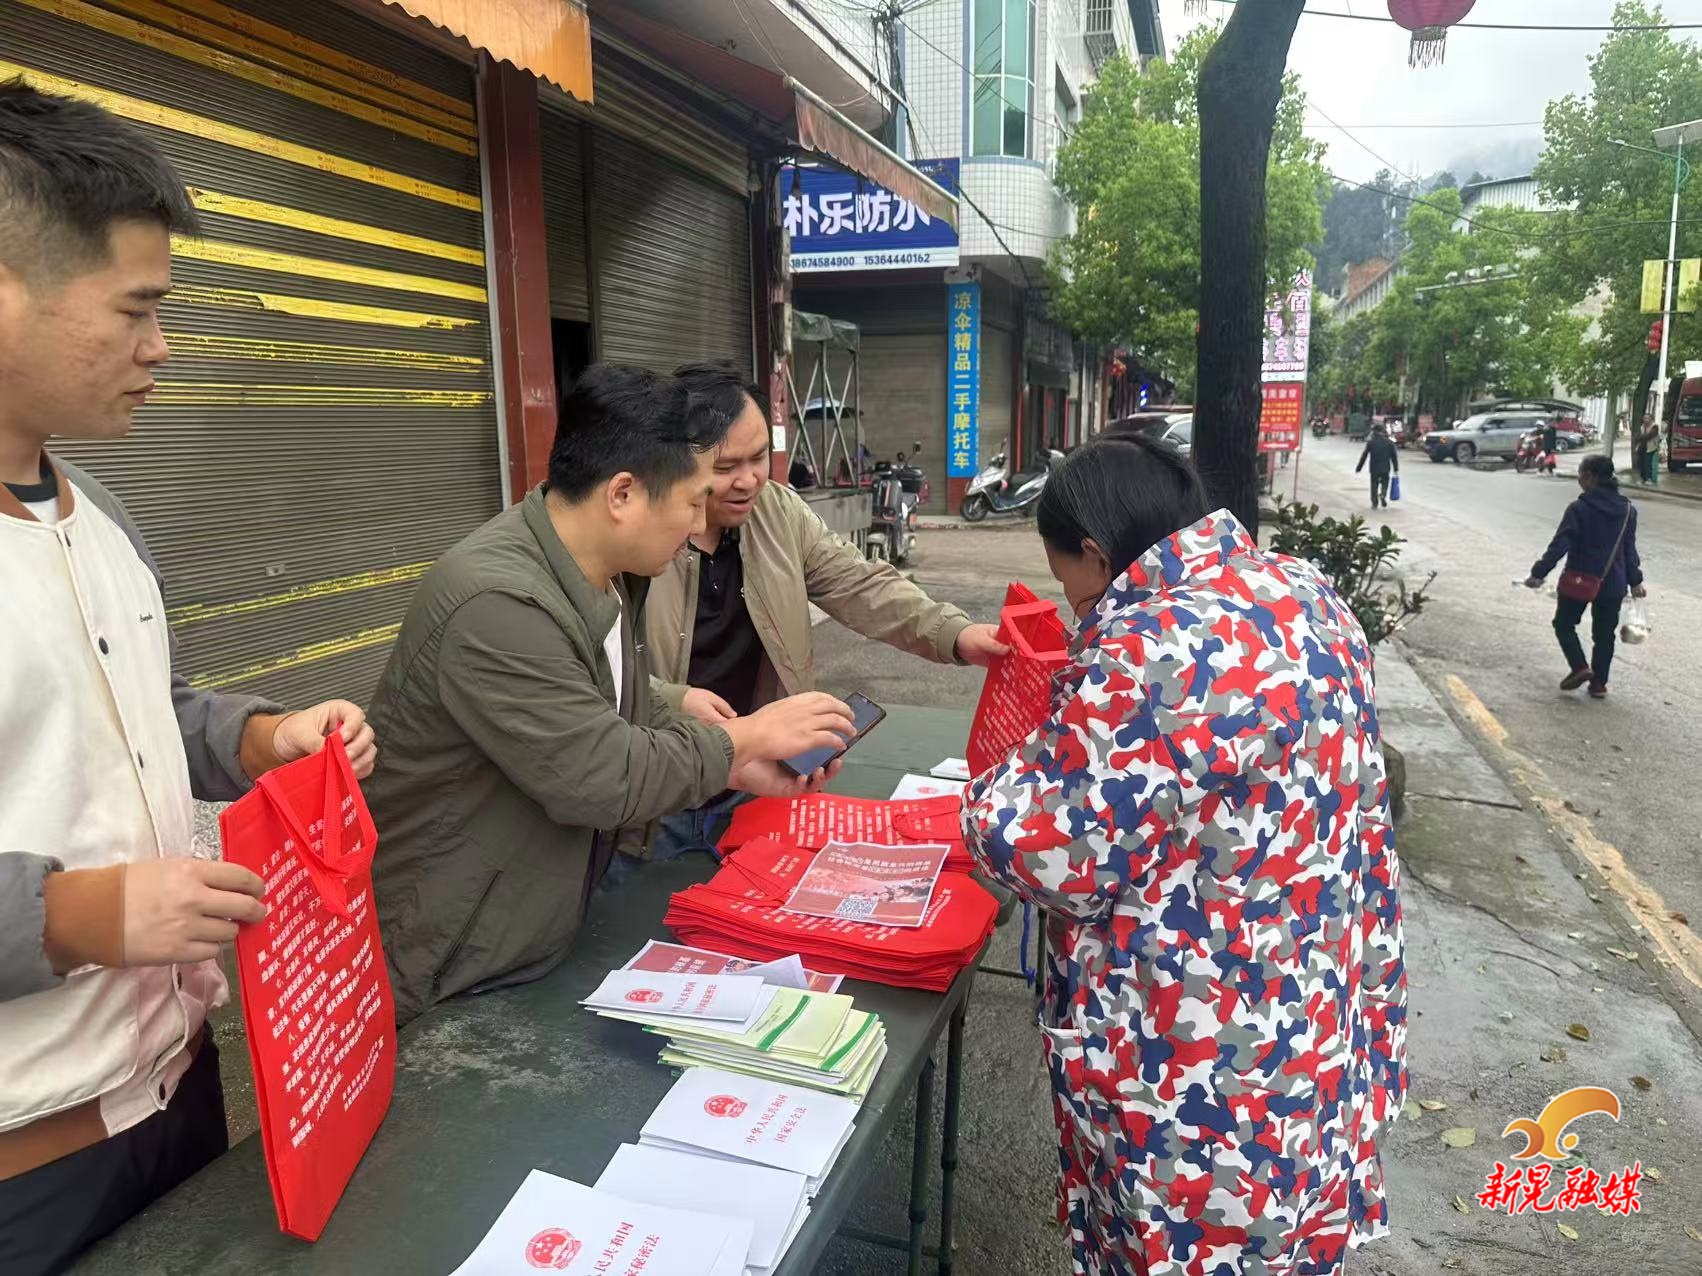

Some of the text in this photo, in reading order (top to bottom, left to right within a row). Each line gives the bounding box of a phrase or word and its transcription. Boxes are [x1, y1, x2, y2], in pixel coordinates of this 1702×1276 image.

[783, 190, 931, 237] 朴乐防水
[864, 253, 931, 266] 15364440162
[953, 292, 972, 469] 凉伞精品二手摩托车
[746, 1094, 788, 1143] 中华人民共和国
[774, 1107, 806, 1143] 国家安全法
